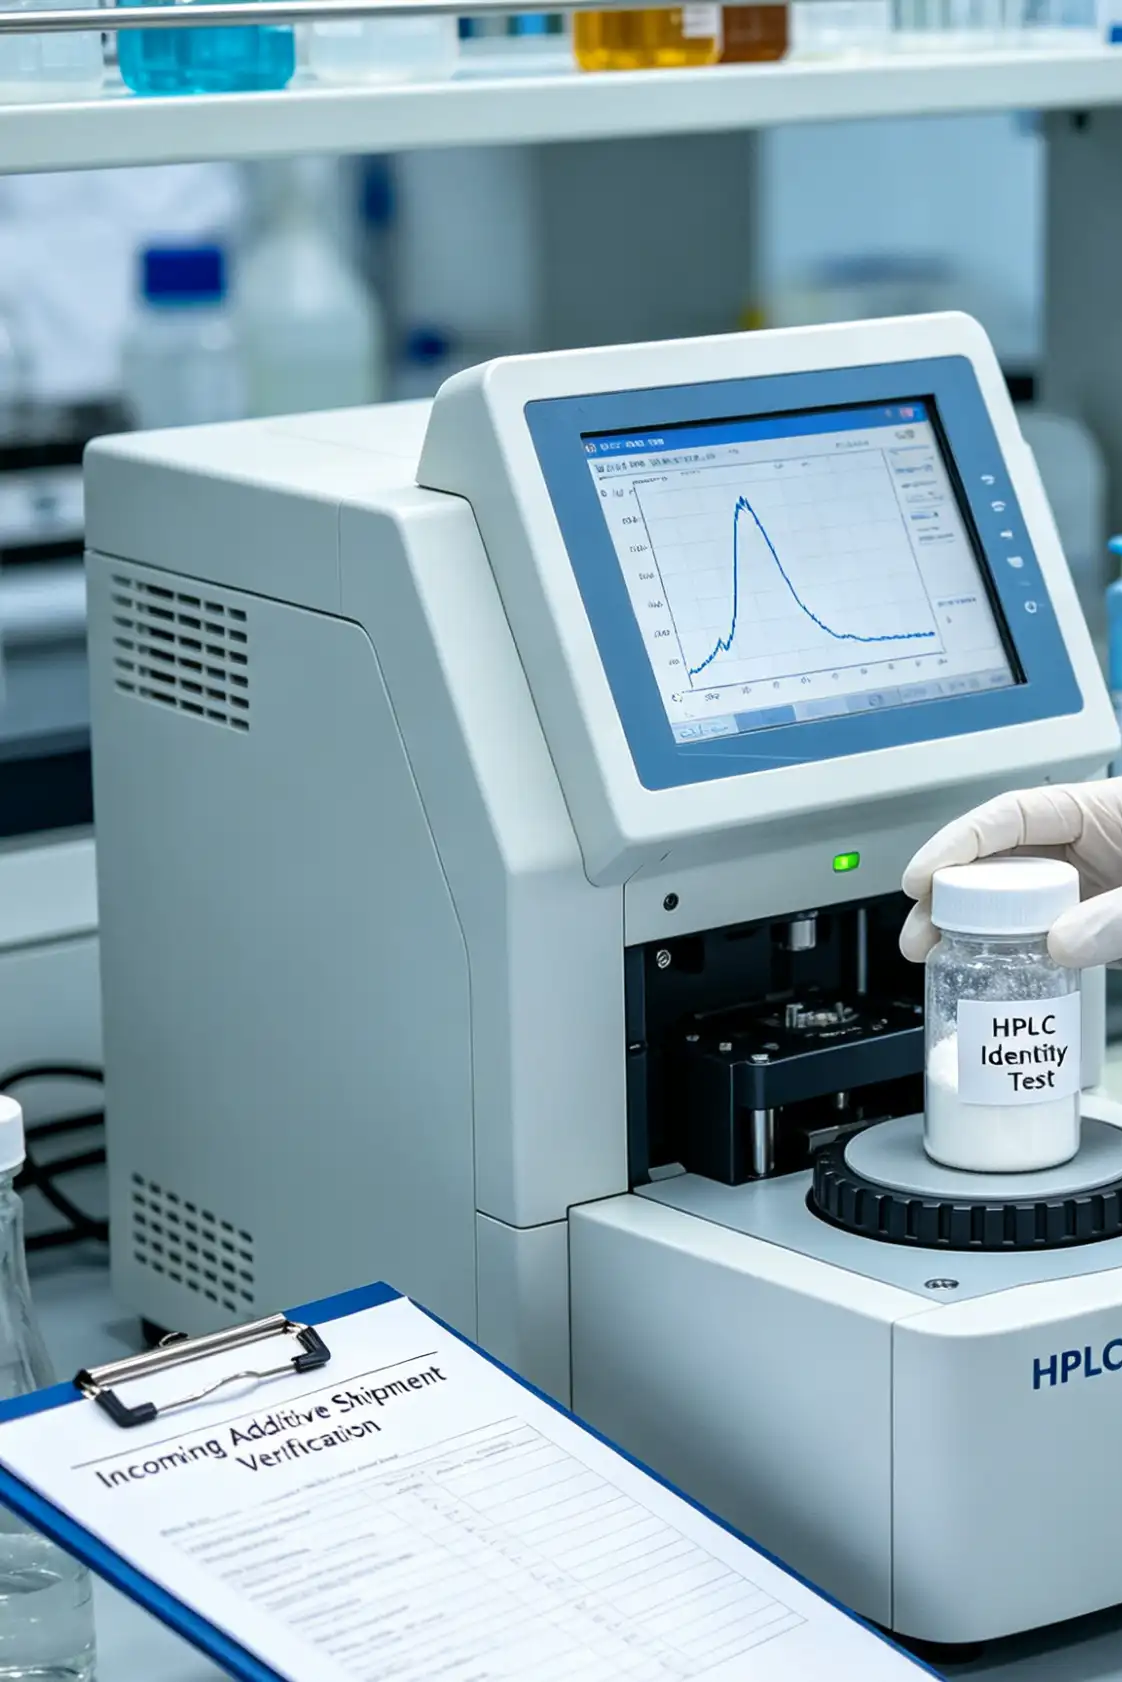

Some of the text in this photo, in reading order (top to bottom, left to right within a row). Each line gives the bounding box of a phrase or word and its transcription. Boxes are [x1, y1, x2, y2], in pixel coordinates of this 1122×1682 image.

[992, 1014, 1057, 1038] HPLC
[981, 1043, 1068, 1068] Identity
[1007, 1070, 1056, 1092] Test
[95, 1365, 448, 1489] Incoming Additive Shipment
[235, 1418, 383, 1473] Verification
